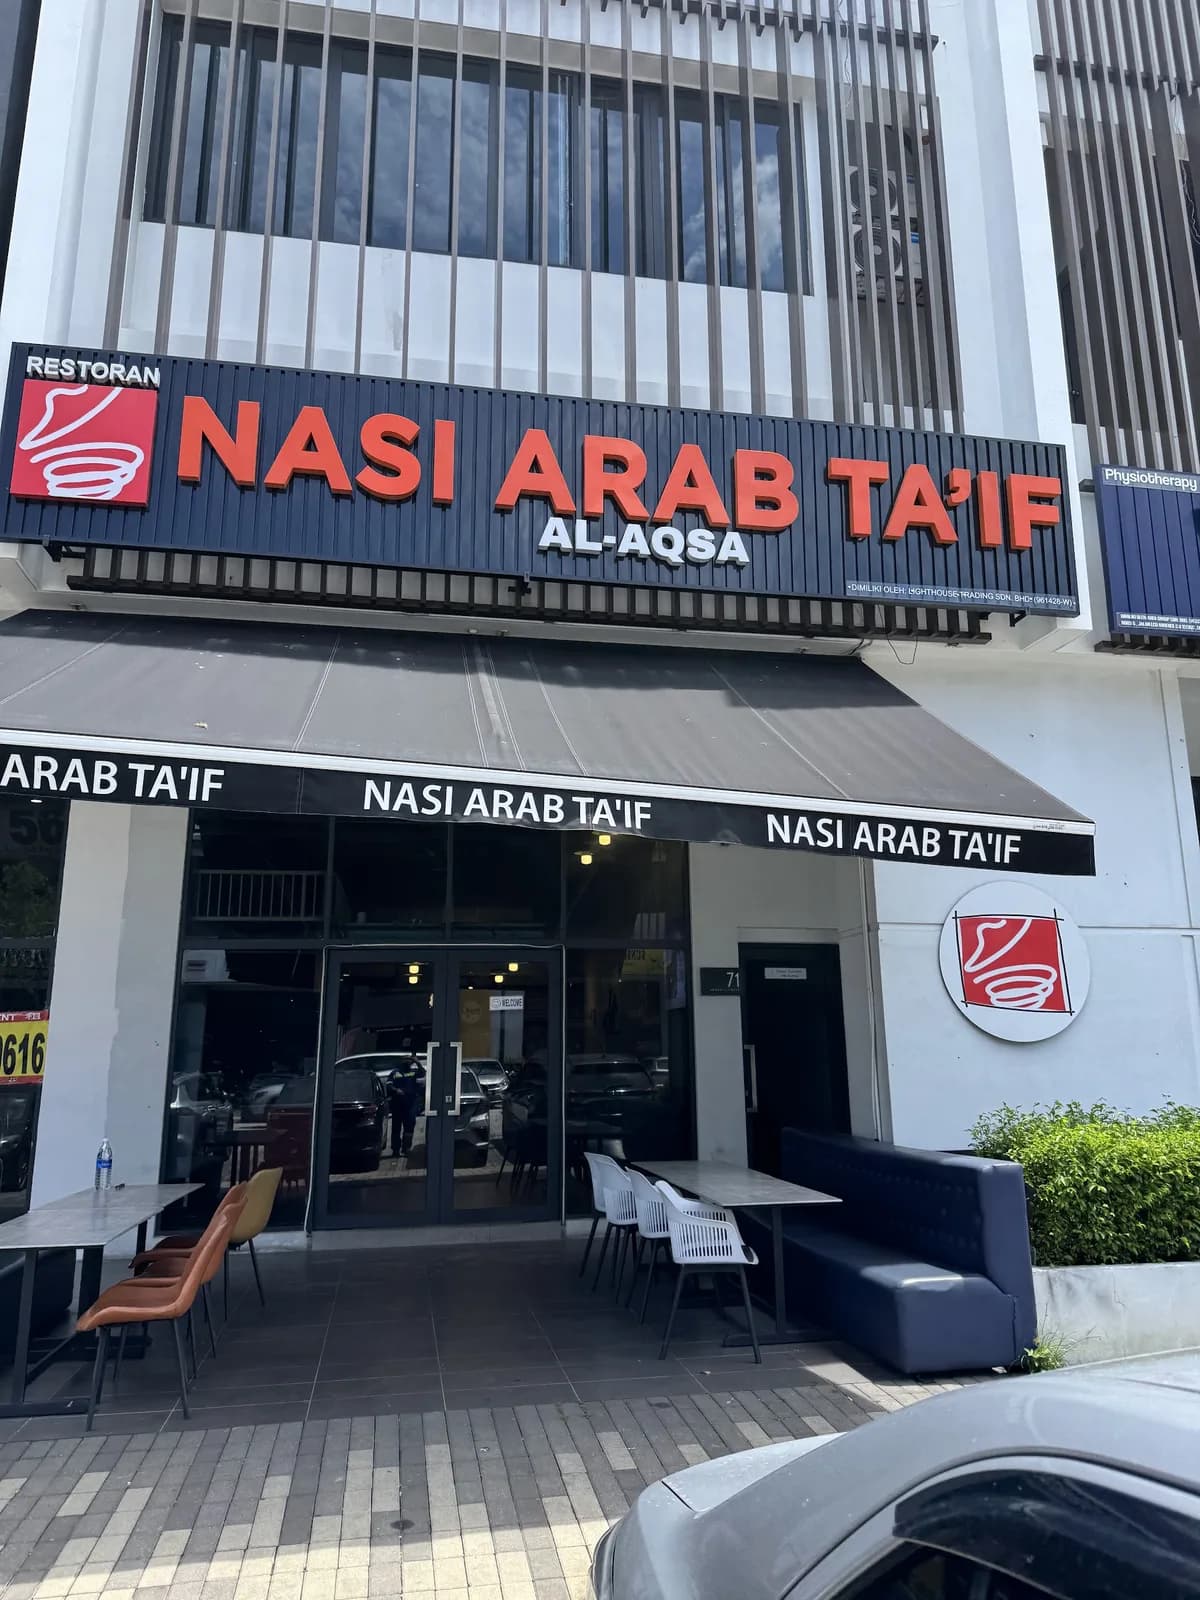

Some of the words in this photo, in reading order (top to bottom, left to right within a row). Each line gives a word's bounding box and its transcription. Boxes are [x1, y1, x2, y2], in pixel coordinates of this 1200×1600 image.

[26, 355, 161, 387] RESTORAN
[177, 396, 457, 504] NASI
[495, 428, 799, 530] ARAB
[827, 457, 1061, 550] TA'IF
[1104, 468, 1198, 491] Physiotherapy
[538, 516, 750, 566] AL-AQSA
[908, 587, 958, 598] LIGHTHOUSE
[959, 591, 994, 601] TRADING
[0, 753, 119, 796] ARAB
[128, 762, 225, 802] TA'IF
[363, 779, 454, 816] NASI
[463, 787, 565, 824] ARAB
[572, 796, 652, 830] TA'IF
[766, 813, 844, 849] NASI
[853, 821, 941, 858] ARAB
[948, 830, 1023, 864] TA'IF
[726, 971, 740, 988] 71
